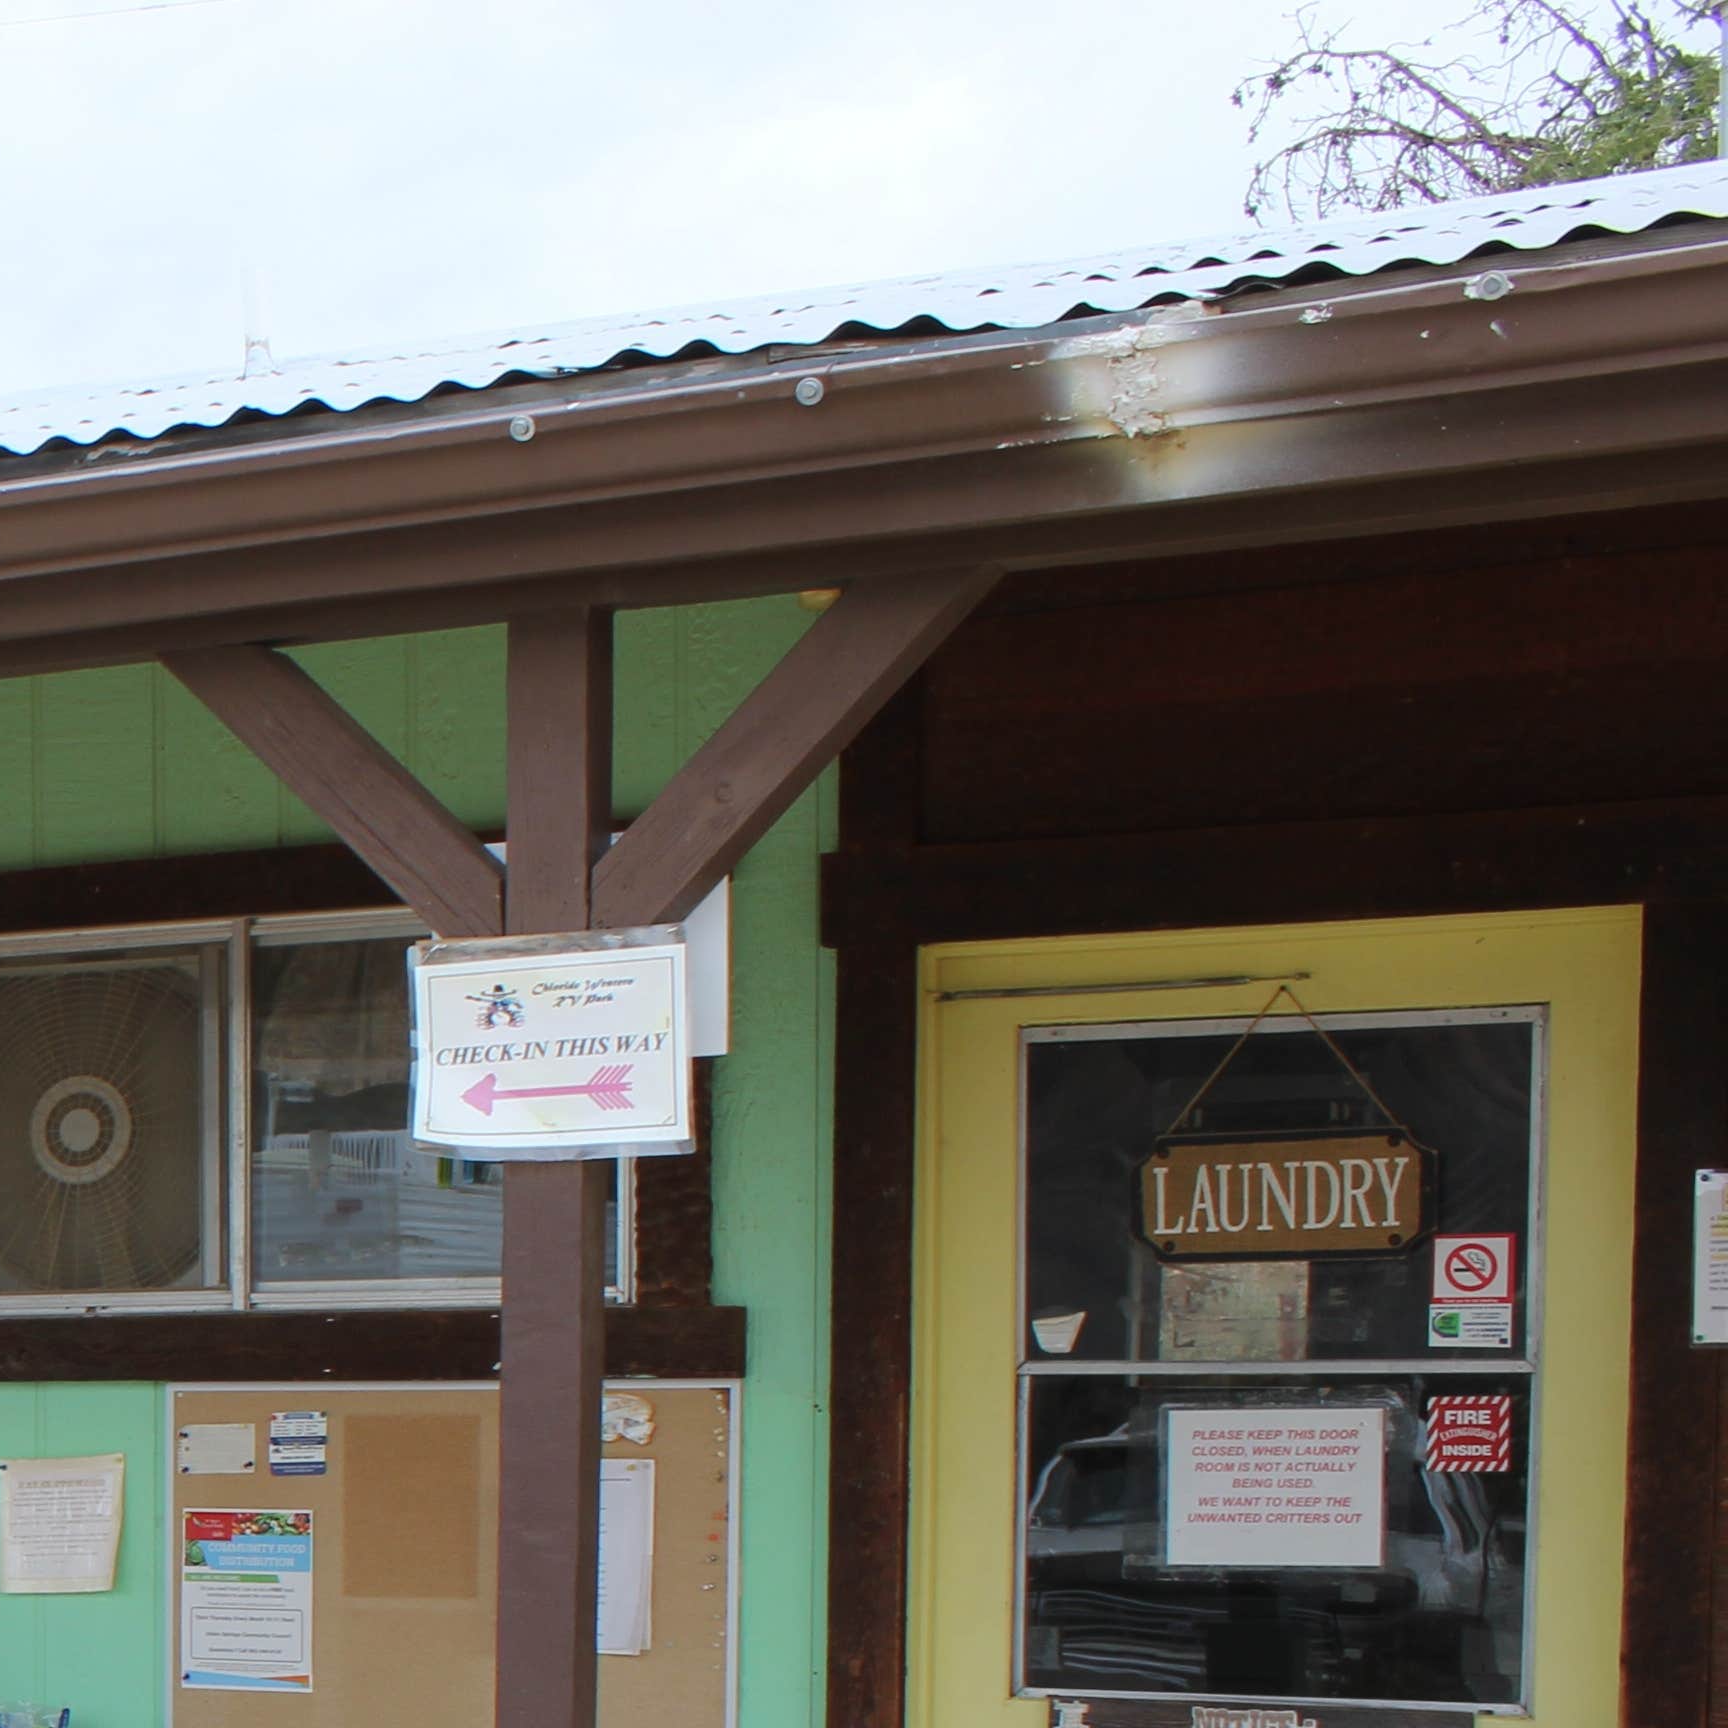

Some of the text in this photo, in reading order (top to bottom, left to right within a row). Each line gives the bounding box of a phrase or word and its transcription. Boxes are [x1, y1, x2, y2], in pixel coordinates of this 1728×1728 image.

[436, 1032, 667, 1066] CHECK-IN THIS WAY
[1151, 1155, 1411, 1236] LAUNDRY
[1444, 1410, 1491, 1425] FIRE
[1192, 1429, 1360, 1440] PLEASE KEEP THIS DOOR
[1252, 1446, 1292, 1456] WHEN
[1296, 1446, 1360, 1456] LAUNDRY
[1443, 1445, 1492, 1456] INSIDE
[1195, 1462, 1357, 1472] ROOM IS NOT ACTUALLY
[1232, 1479, 1273, 1488] BEING
[1199, 1497, 1352, 1507] WE WANT TO KEEP THE
[1188, 1513, 1363, 1524] UNWANTED CRITTERS OUT
[277, 1544, 306, 1553] FOOD
